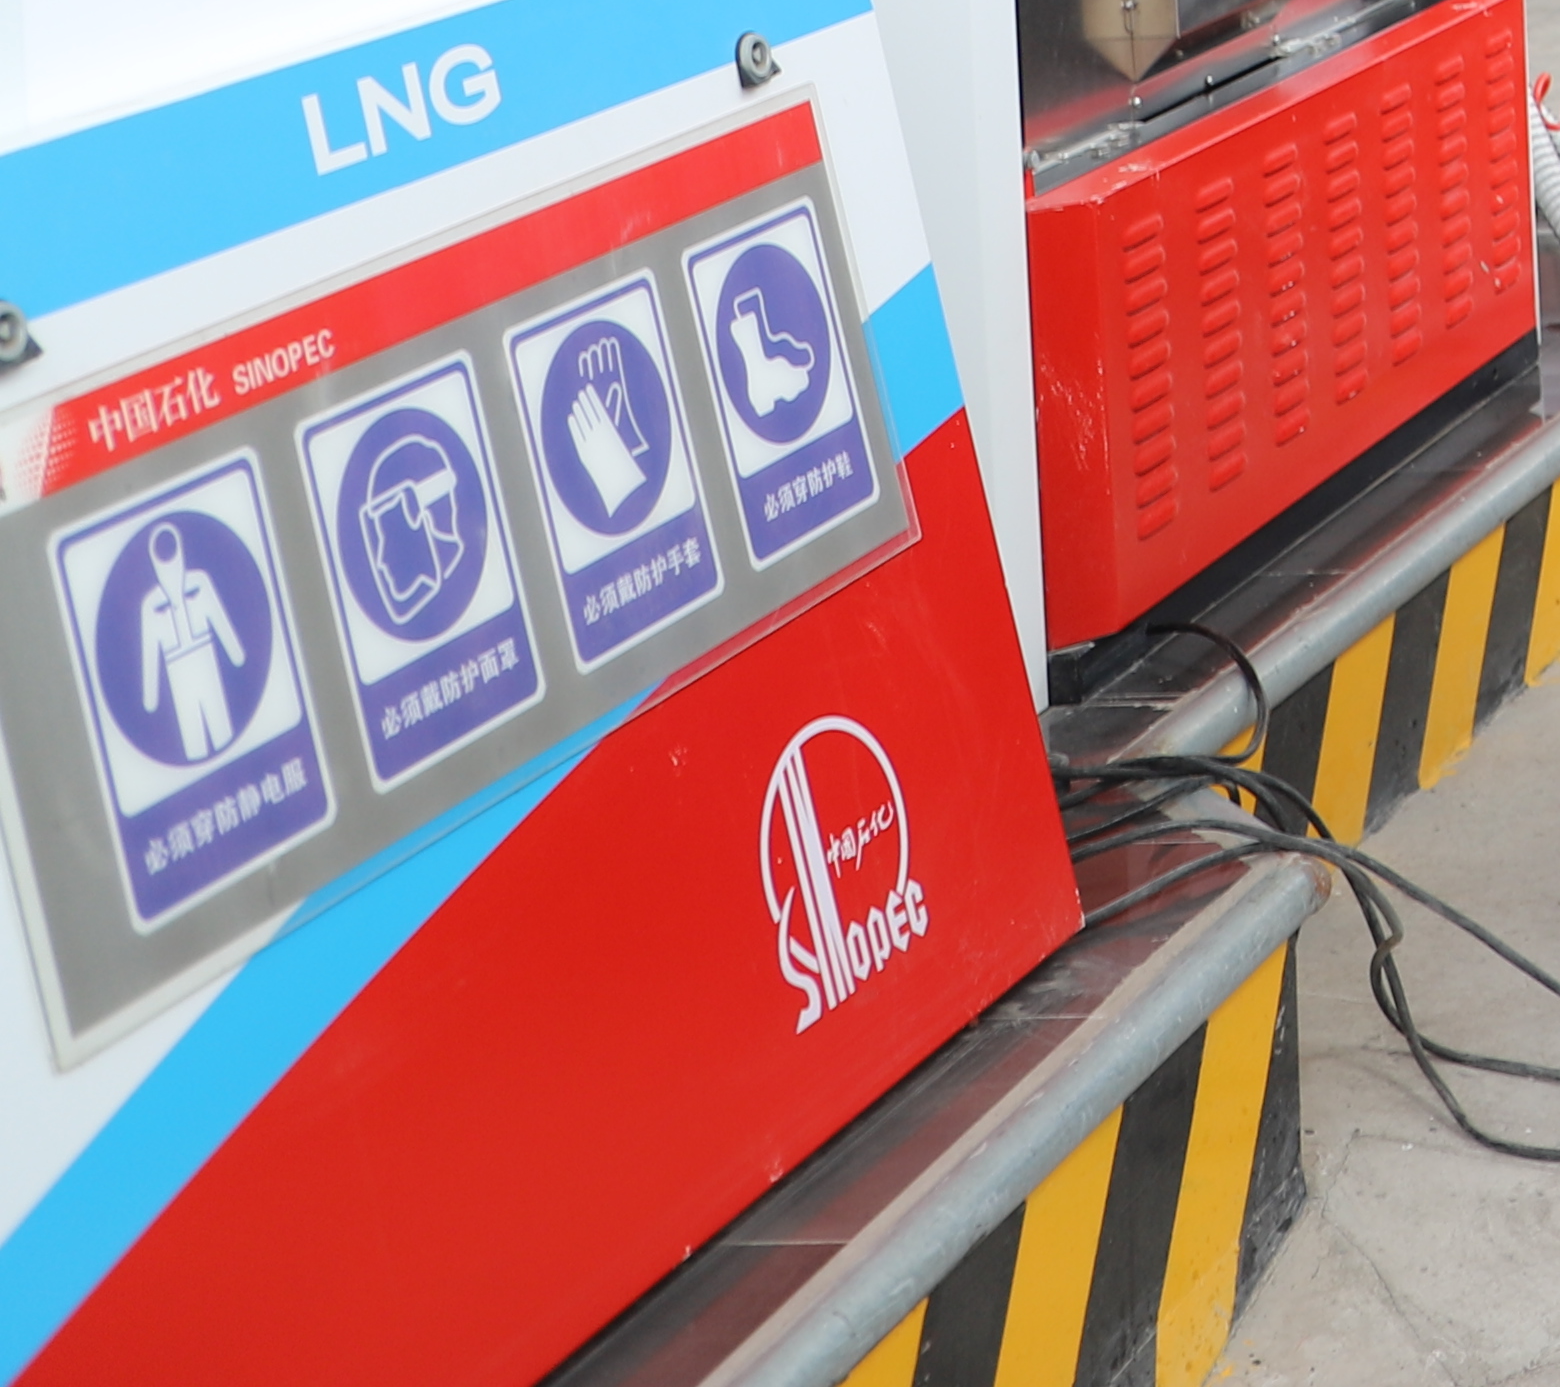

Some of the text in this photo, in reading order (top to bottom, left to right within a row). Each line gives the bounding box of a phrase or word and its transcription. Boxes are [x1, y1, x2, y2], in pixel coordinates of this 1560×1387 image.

[300, 44, 501, 178] LNG
[88, 328, 335, 458] 中国石化 SINOPEC
[763, 453, 854, 523] 必须穿防护鞋
[582, 537, 701, 626] 必须戴防护手套
[381, 641, 521, 740] 必须戴防护面罩
[144, 760, 308, 876] 必须穿防静电服
